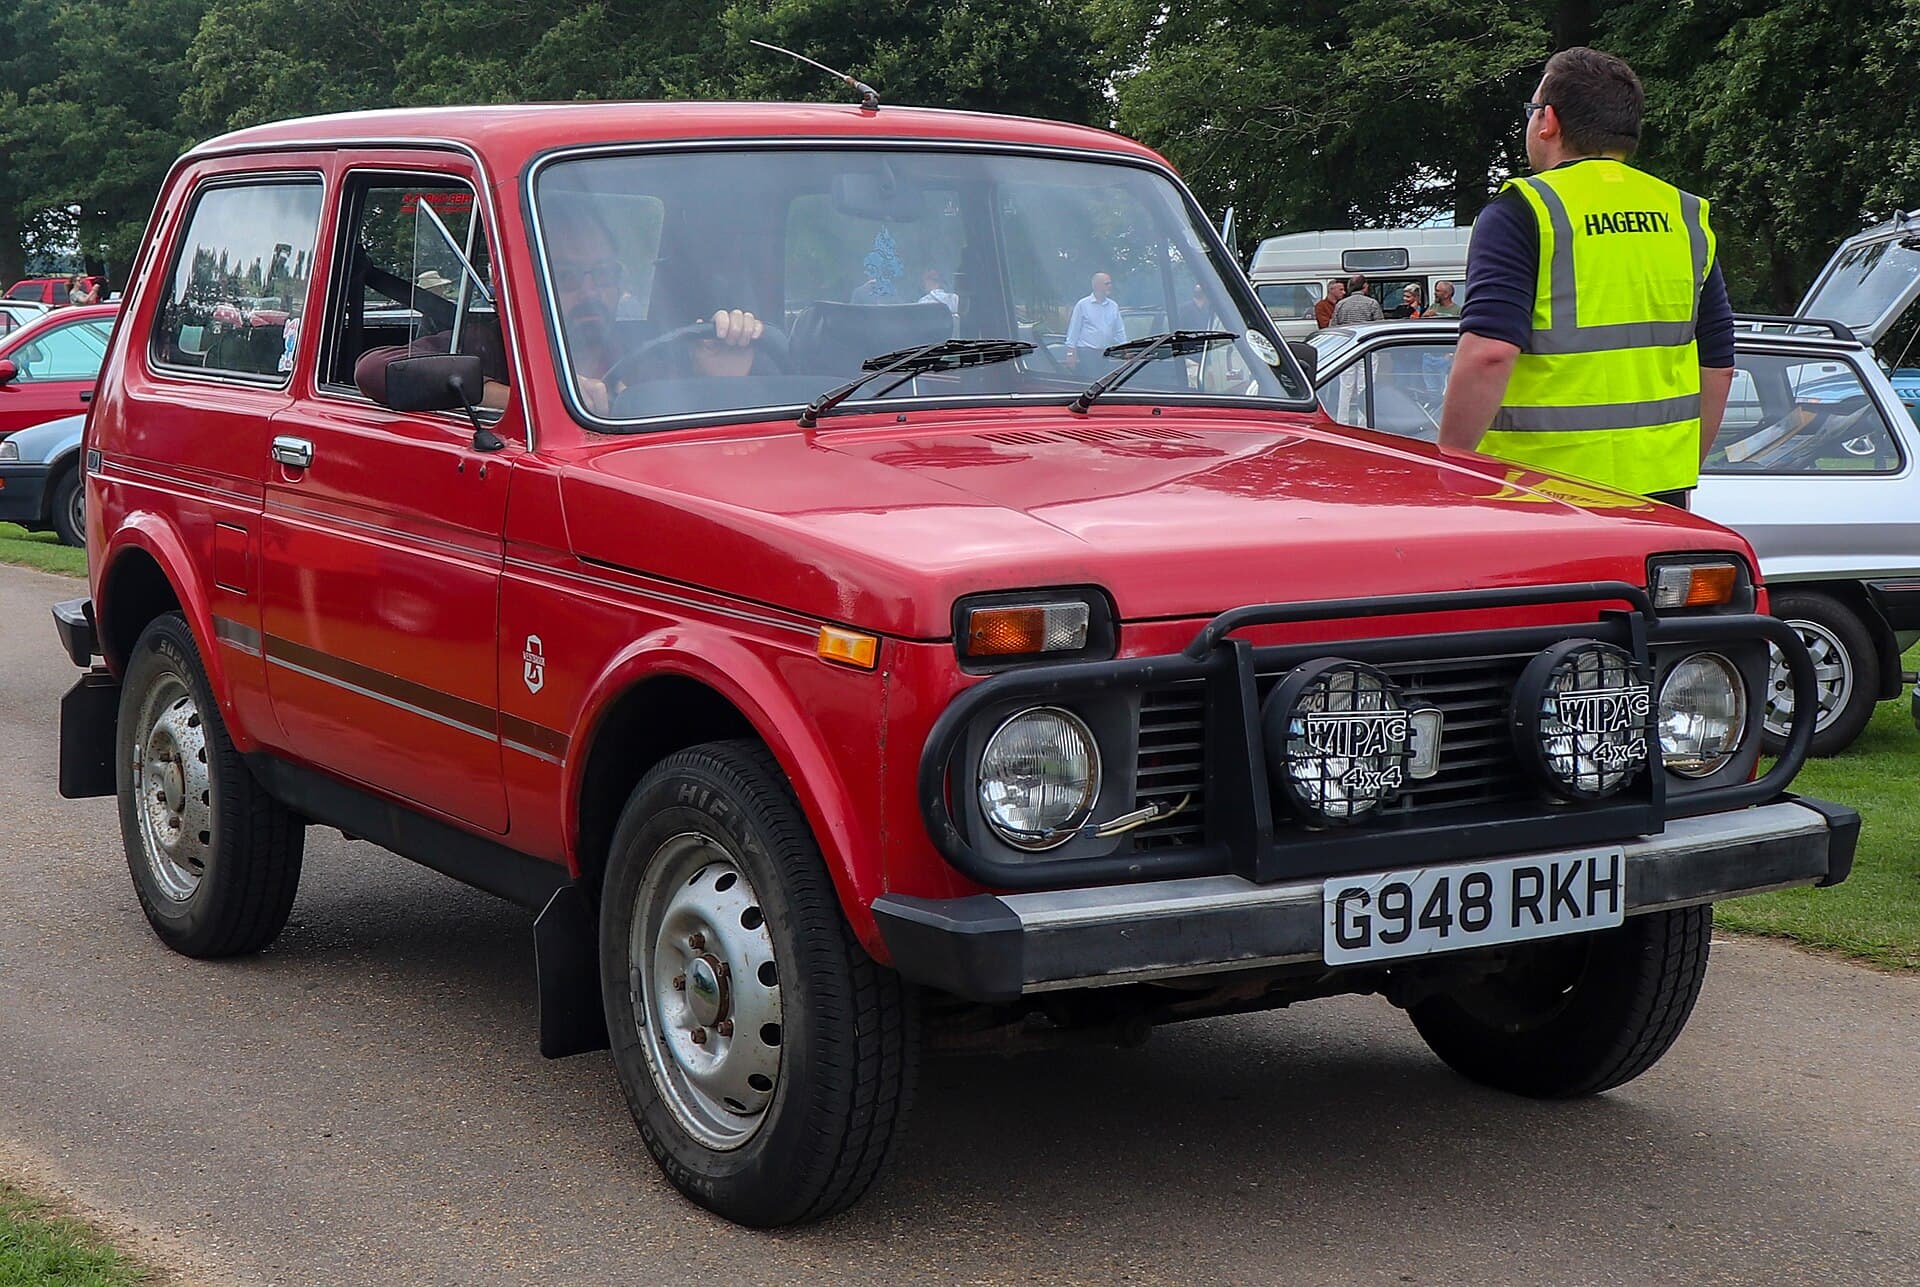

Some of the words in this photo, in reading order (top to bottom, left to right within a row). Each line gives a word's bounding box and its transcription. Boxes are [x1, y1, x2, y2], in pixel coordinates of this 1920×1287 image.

[1560, 692, 1649, 733] WIPAC
[1308, 718, 1406, 757] WIPAC
[1593, 738, 1647, 763] 4x4
[1342, 765, 1402, 790] 4x4
[678, 783, 760, 854] HIFLY
[1335, 871, 1493, 950] G948
[1511, 854, 1619, 928] RKH
